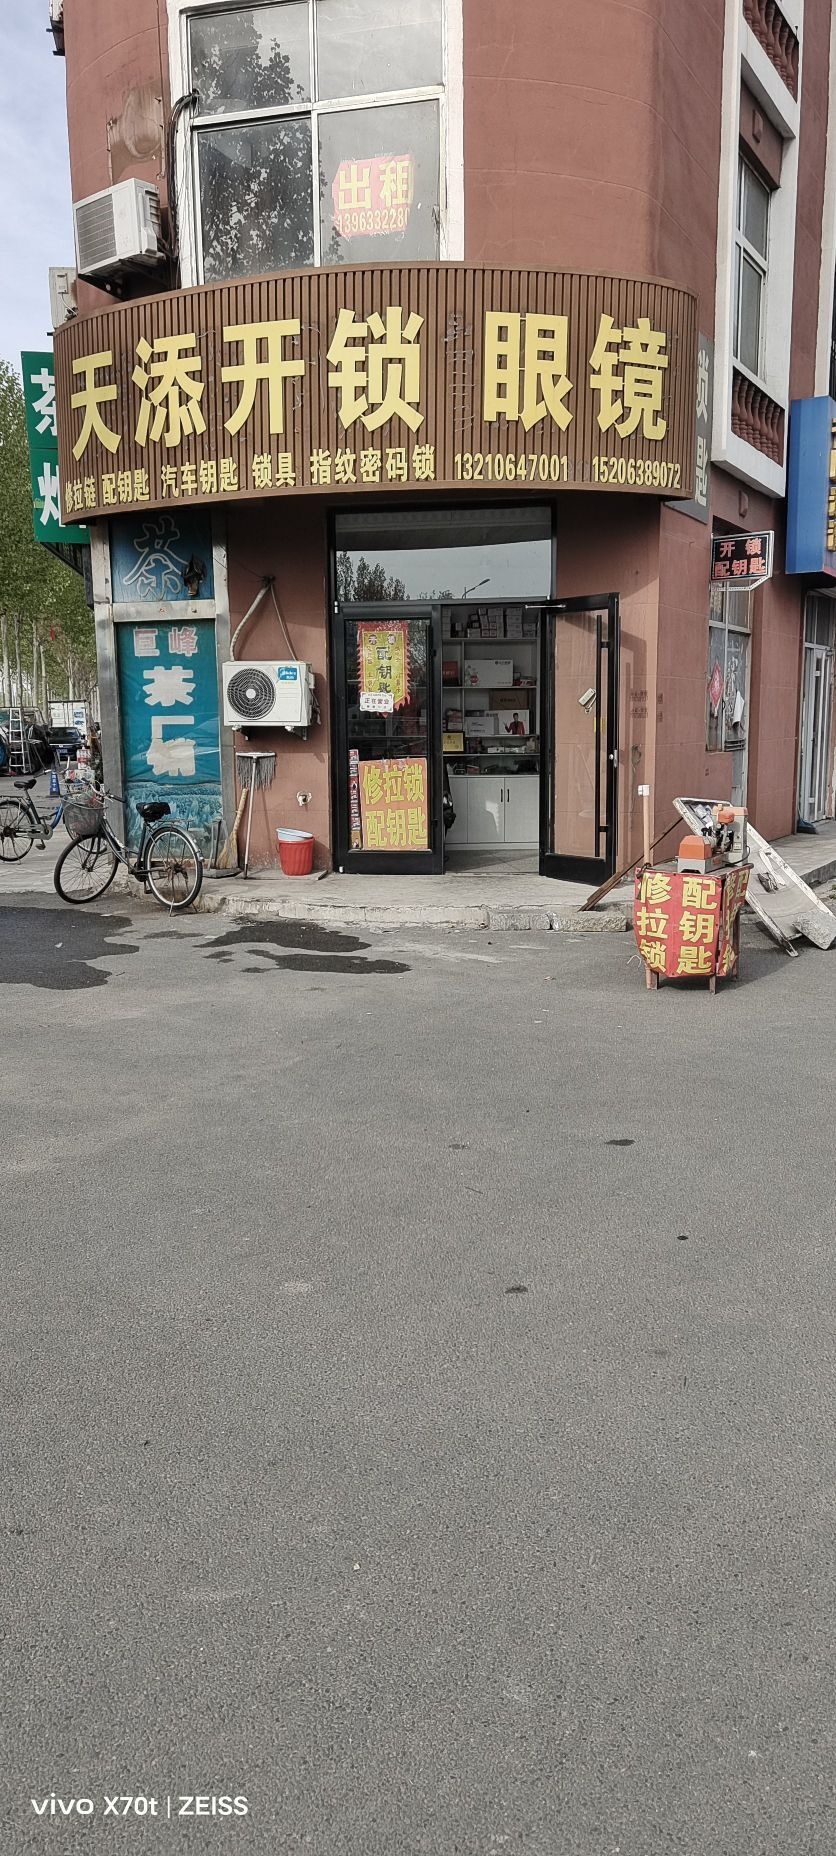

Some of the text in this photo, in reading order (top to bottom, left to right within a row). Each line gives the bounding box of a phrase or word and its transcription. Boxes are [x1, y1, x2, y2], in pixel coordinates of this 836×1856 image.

[339, 161, 413, 209] 出租
[70, 306, 669, 461] 天添开锁 眼镜
[65, 443, 682, 514] 修拉链 配钥匙 汽车钥匙 锁具 指纹密码锁 13210647001 15206389072
[714, 556, 766, 578] 配钥匙
[720, 537, 762, 558] 开锁
[133, 626, 199, 657] 巨峰
[362, 763, 425, 804] 修拉锁
[365, 806, 429, 847] 配钥匙
[637, 872, 672, 973] 修拉锁
[676, 876, 718, 975] 配钥匙
